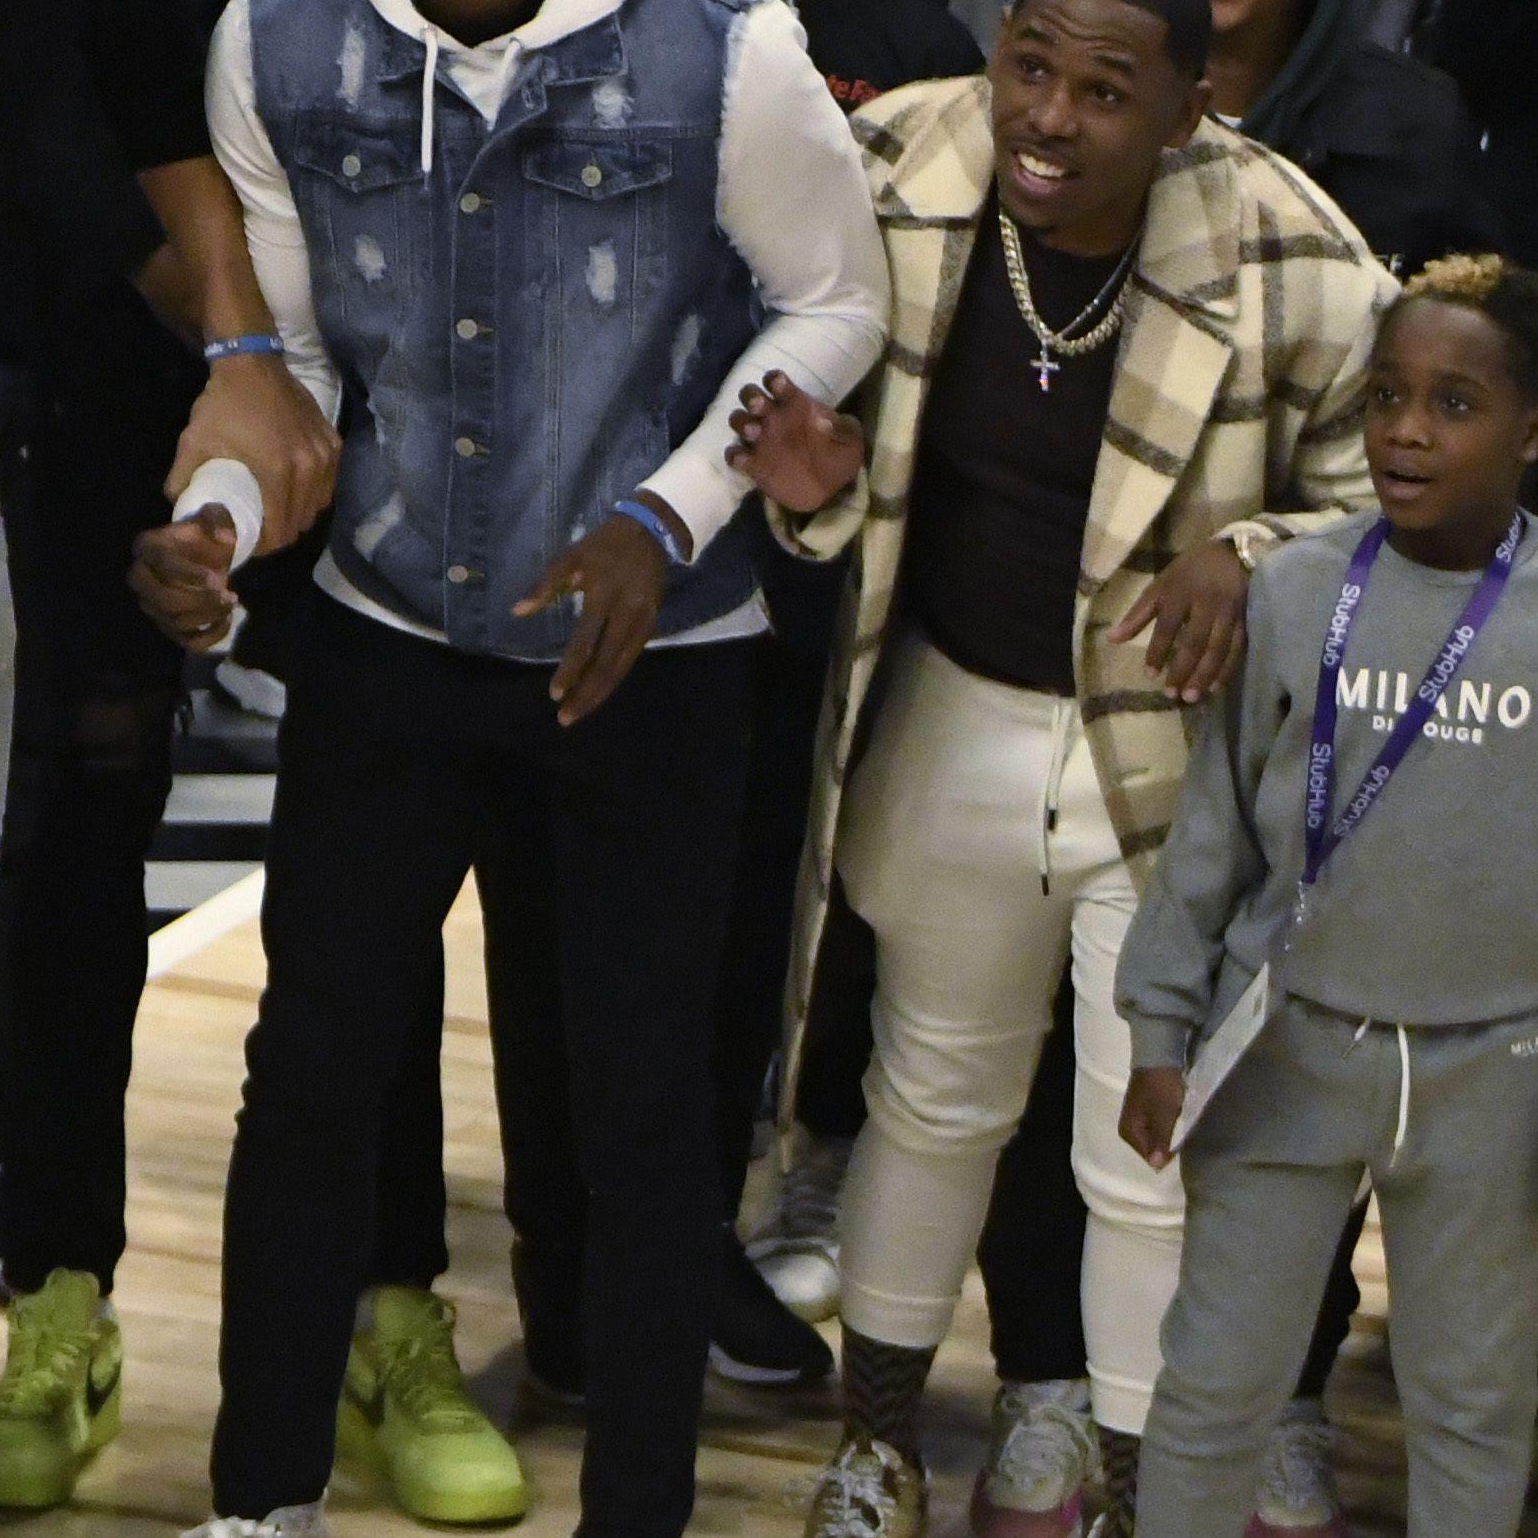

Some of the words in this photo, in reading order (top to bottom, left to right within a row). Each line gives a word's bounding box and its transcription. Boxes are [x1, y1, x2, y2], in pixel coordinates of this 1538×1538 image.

[1323, 583, 1361, 666] StubHub
[1418, 625, 1474, 702] StubHub
[1307, 742, 1332, 830] StubHub
